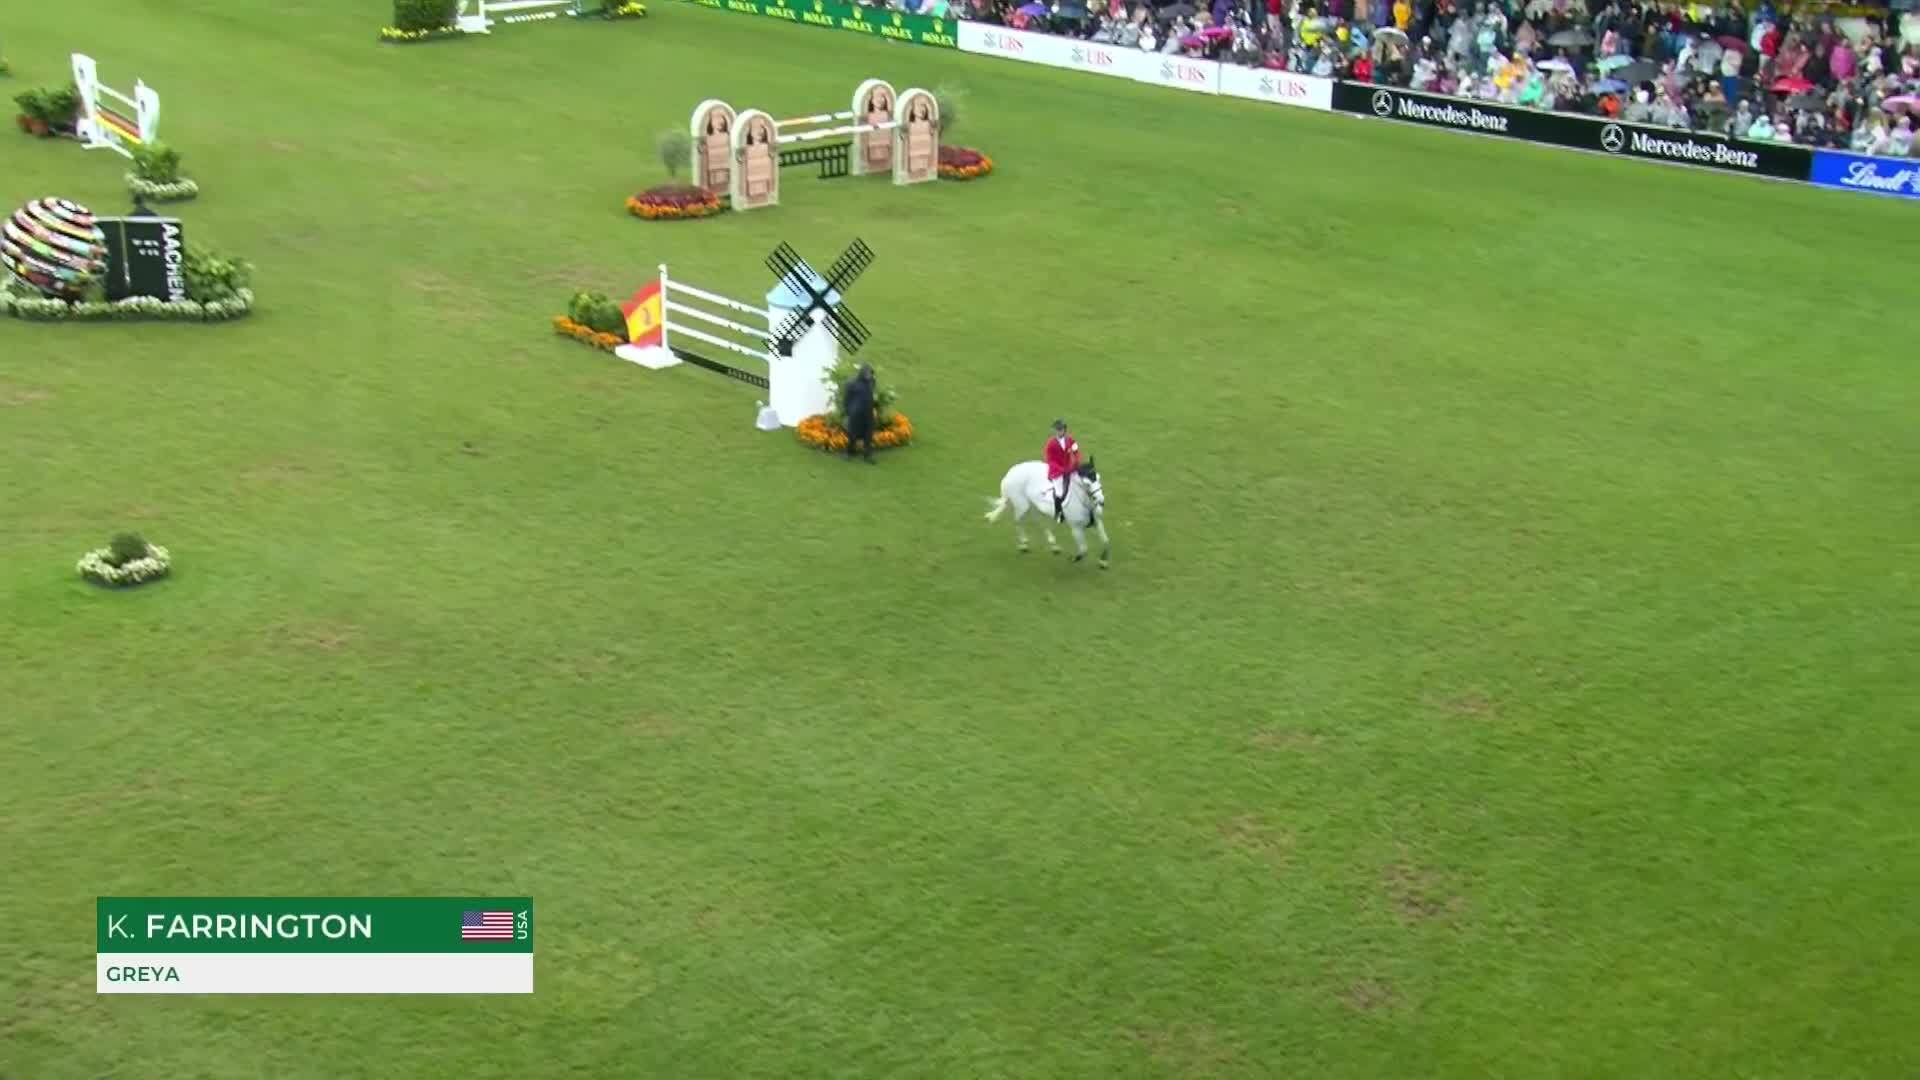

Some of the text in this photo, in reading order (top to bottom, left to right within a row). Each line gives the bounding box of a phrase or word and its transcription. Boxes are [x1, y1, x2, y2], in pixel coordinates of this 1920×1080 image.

[728, 0, 759, 13] ROLEX
[766, 5, 798, 21] ROLEX
[803, 11, 834, 26] ROLEX
[841, 17, 873, 32] ROLEX
[880, 24, 913, 40] ROLEX
[921, 31, 956, 47] ROLEX
[998, 36, 1025, 53] UBS
[1087, 47, 1113, 65] UBS
[1176, 59, 1206, 81] UBS
[1277, 74, 1307, 97] UBS
[1397, 97, 1509, 132] Mercedes-Benz
[1630, 131, 1759, 168] Mercedes-Benz
[1839, 160, 1911, 192] Lindt
[162, 223, 185, 302] AACHEN
